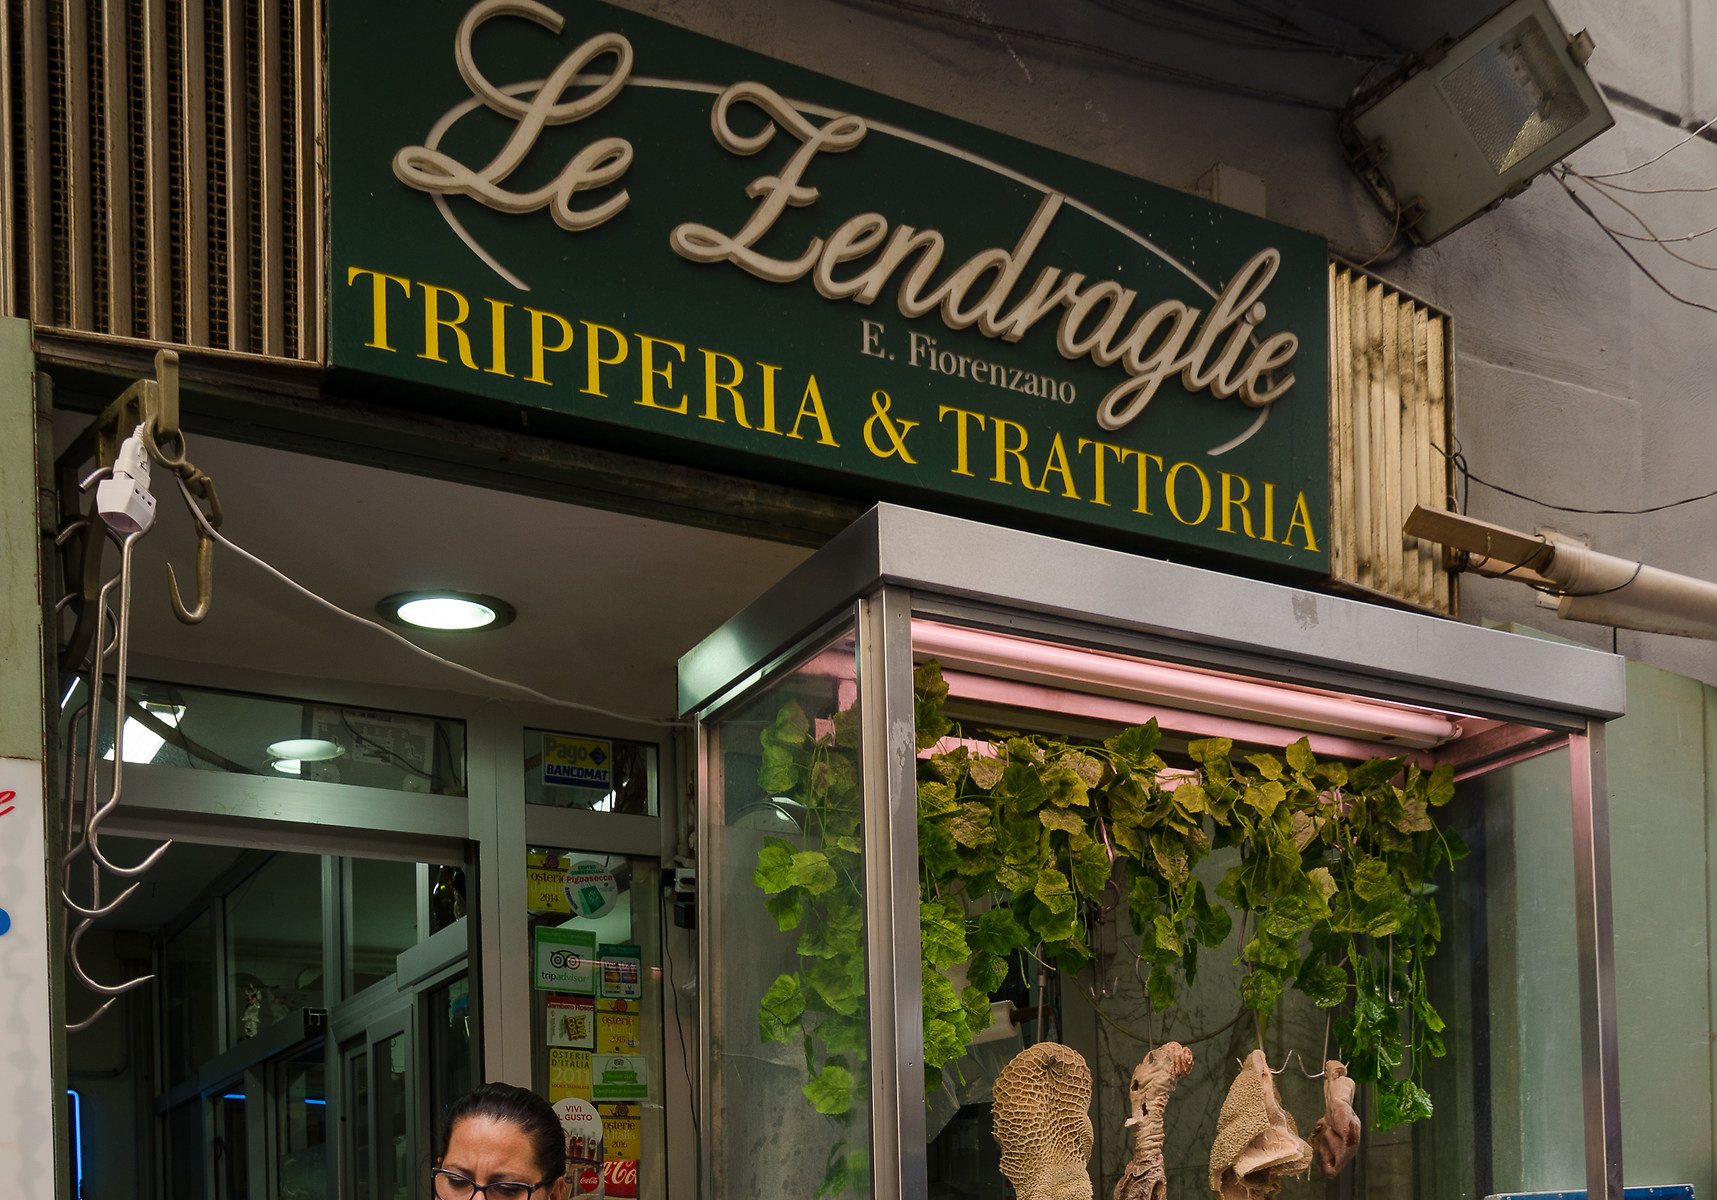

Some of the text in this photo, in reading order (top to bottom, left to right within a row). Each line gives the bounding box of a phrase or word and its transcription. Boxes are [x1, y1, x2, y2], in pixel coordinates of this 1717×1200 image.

[393, 0, 1299, 431] Le Zendraglie
[860, 319, 1077, 405] E. Fiorenzano
[347, 265, 1322, 553] TRIPPERIA & TRATTORIA
[546, 737, 588, 765] Pago
[546, 763, 609, 781] BANCOMAT
[566, 875, 613, 885] Pignasecca
[540, 893, 559, 903] 2014
[541, 971, 587, 983] tripadvisor
[602, 1015, 634, 1027] osterie
[552, 1050, 589, 1060] OSTERIE
[551, 1059, 590, 1069] D'ITALIA
[551, 1067, 590, 1085] 2011
[565, 1105, 582, 1113] VIVI
[603, 1120, 636, 1132] osterie
